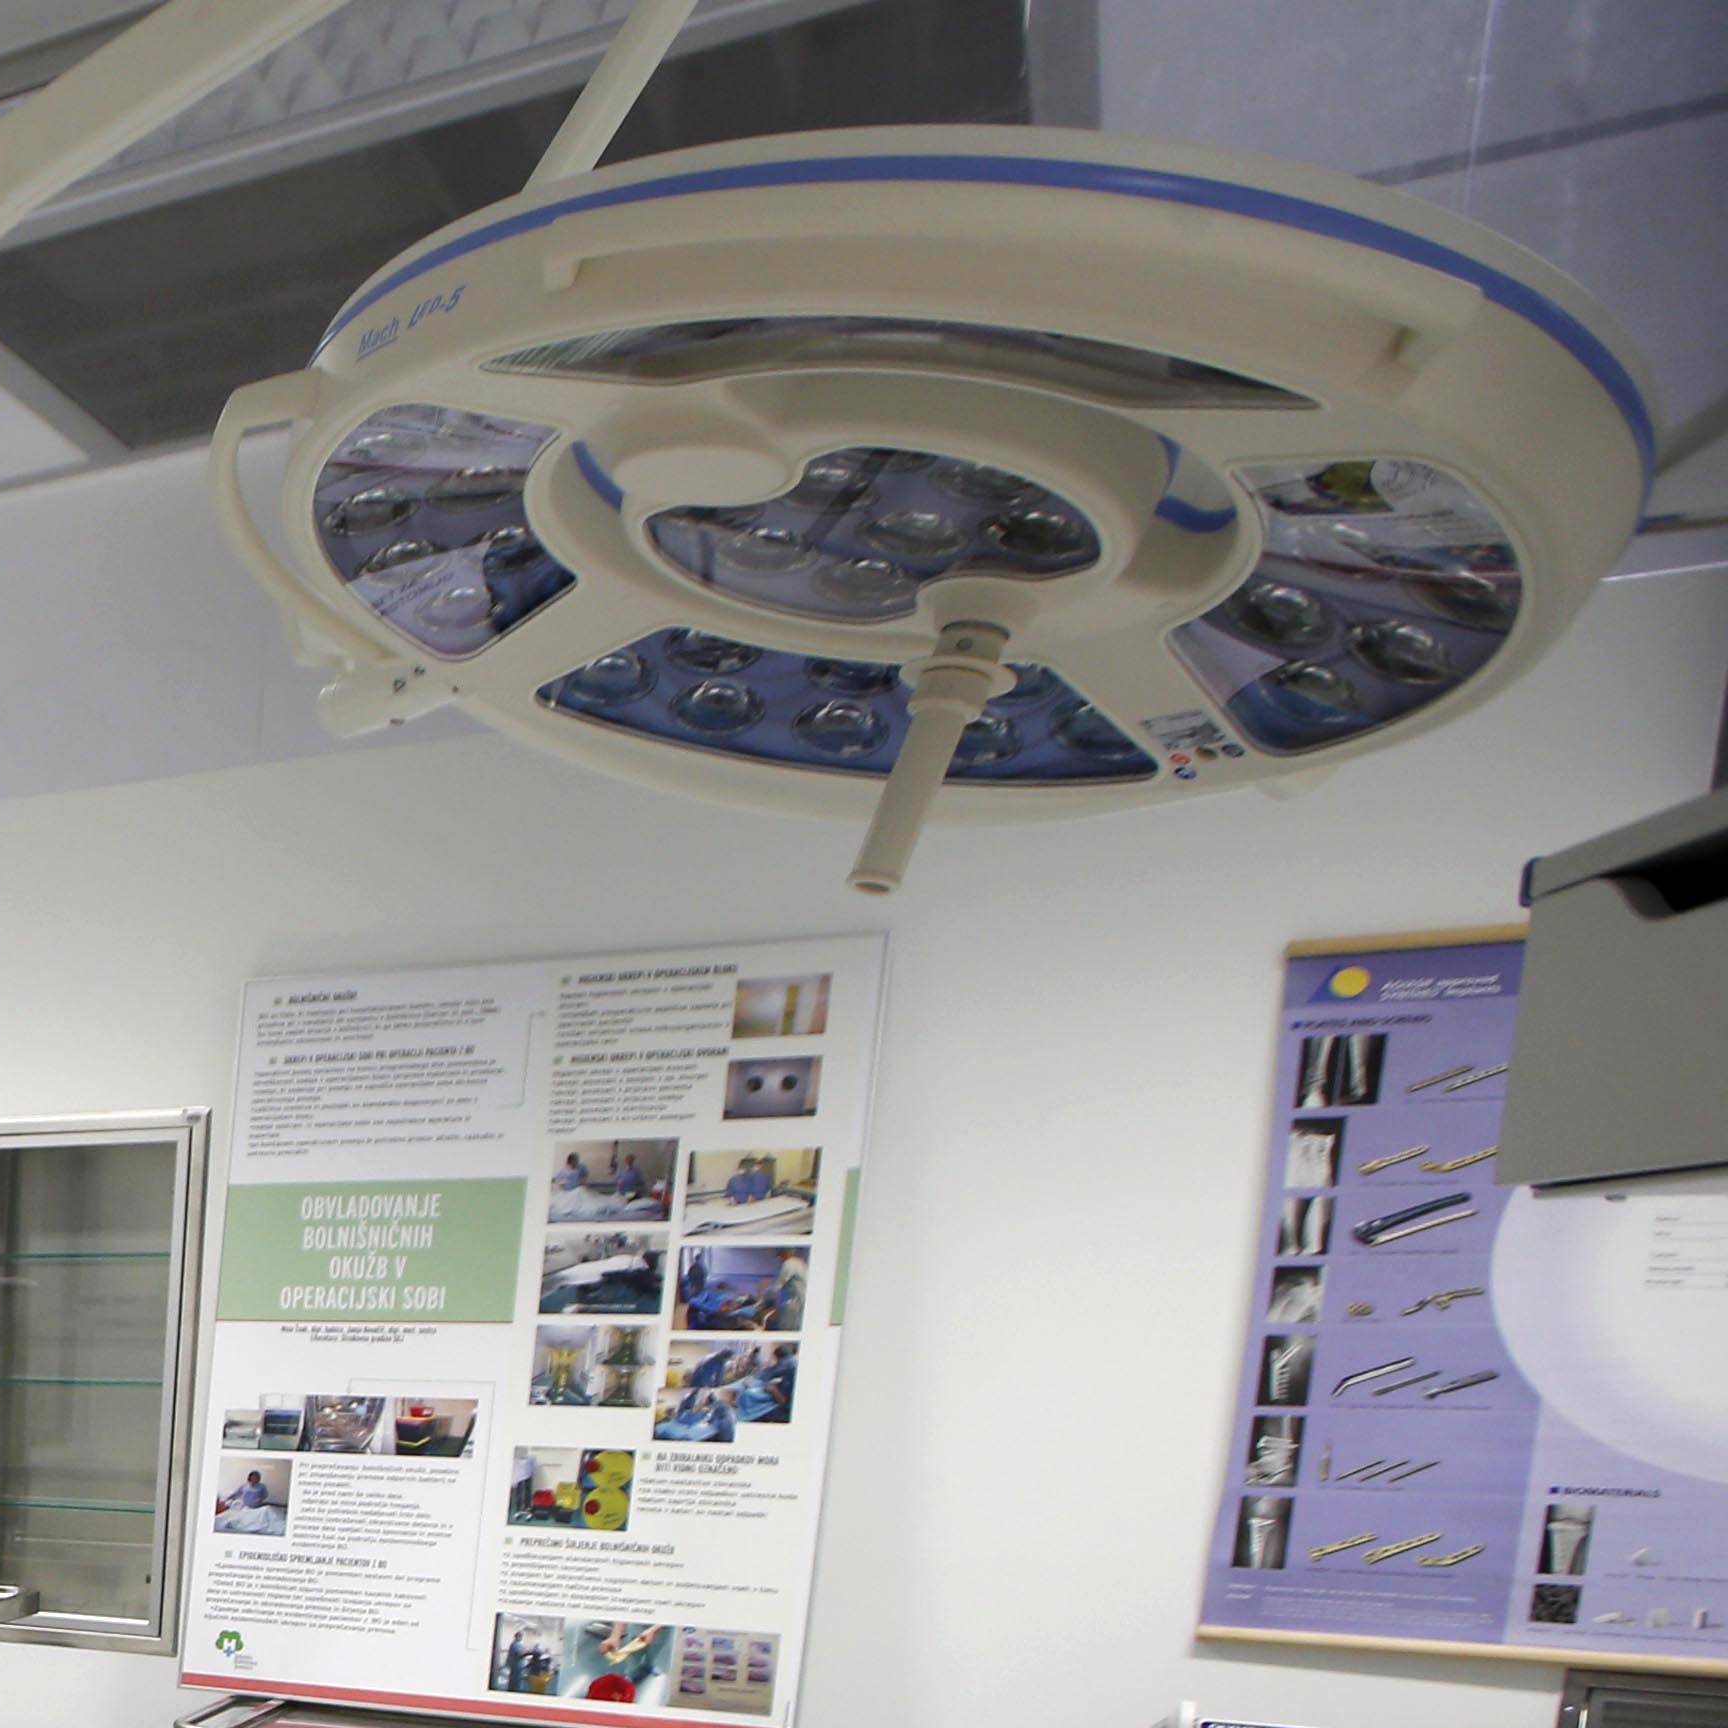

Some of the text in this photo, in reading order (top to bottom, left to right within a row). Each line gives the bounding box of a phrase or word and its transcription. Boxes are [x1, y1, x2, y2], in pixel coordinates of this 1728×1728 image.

[301, 1194, 442, 1220] OBVLADOVANJE
[303, 1219, 433, 1250] BOLNIŠNIČNIH
[329, 1250, 407, 1279] OKUŽB V
[280, 1286, 446, 1310] OPERACIJSKI SOBI
